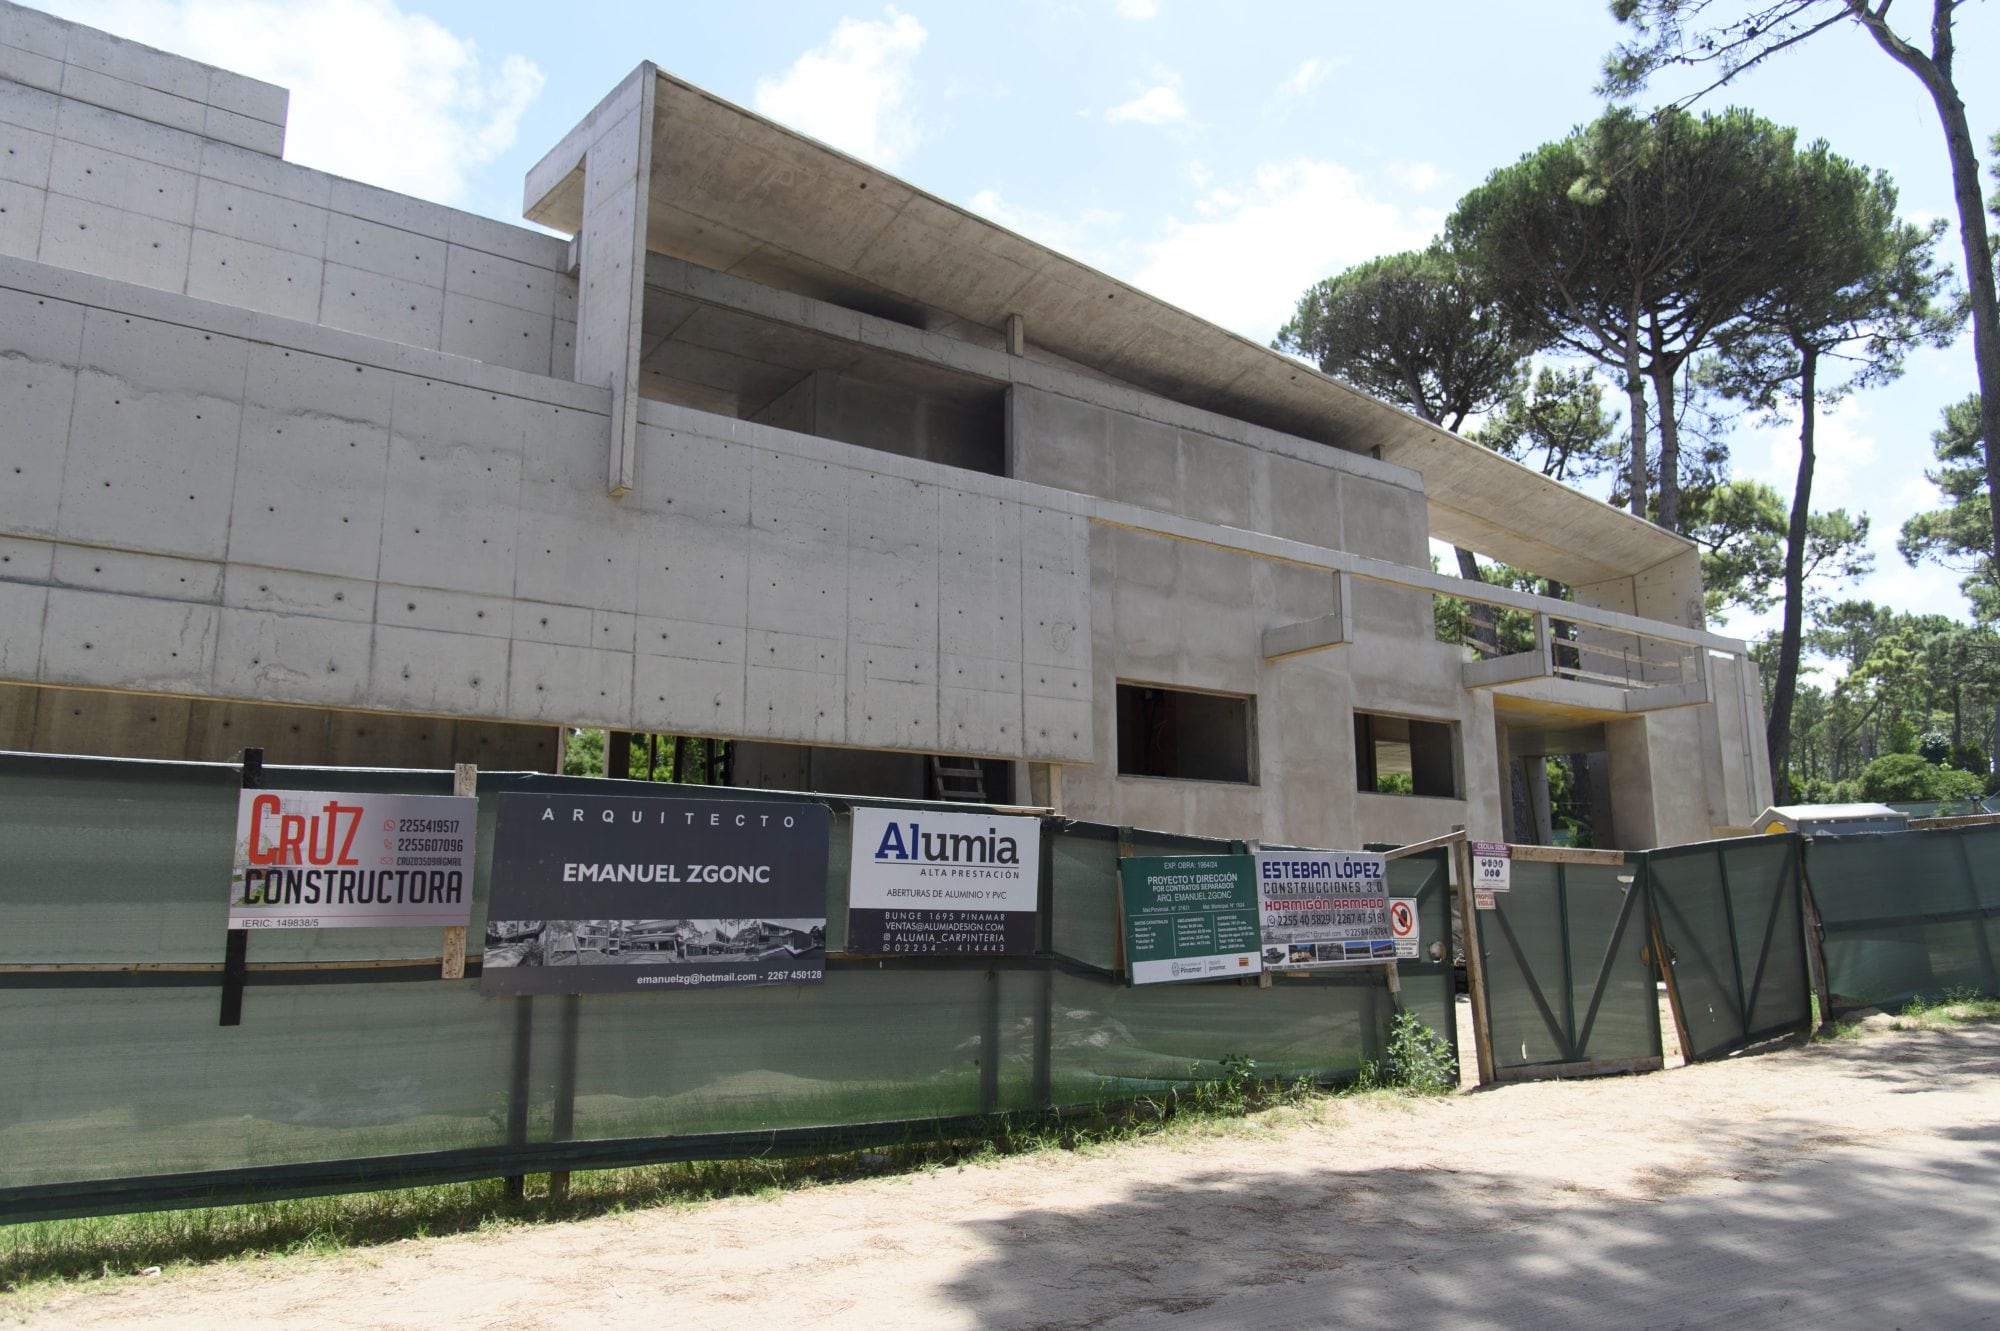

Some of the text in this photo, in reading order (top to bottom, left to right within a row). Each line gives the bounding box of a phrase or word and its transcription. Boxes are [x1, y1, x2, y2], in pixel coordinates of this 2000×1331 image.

[541, 807, 795, 829] ARQUITECTO
[399, 819, 460, 834] 2255419517
[398, 838, 463, 853] 2255607096
[874, 822, 1020, 864] Alumia
[563, 863, 770, 884] EMANUEL ZGONC
[920, 868, 1019, 879] ALTA PRESTACIÓN
[1262, 856, 1380, 879] ESTEBAN LÓPEZ
[1147, 872, 1238, 886] PROYECTO Y DIRECCIÓN
[244, 869, 463, 905] CONSTRUCTORA
[1166, 884, 1200, 892] CONTRATOS
[1200, 882, 1235, 890] SEPARADOS
[1263, 881, 1361, 894] CONSTRUCCIONES
[886, 889, 1007, 900] ABERTURAS DE ALUMINIO Y PVC
[1174, 892, 1207, 901] EMANUEL
[1207, 891, 1232, 900] ZGONC
[1264, 896, 1384, 911] HORMIGÓN ARMADO
[242, 918, 319, 928] IERIC: 149838/5
[885, 911, 1005, 921] BUNGE 1695 PINAMAR
[1277, 915, 1298, 927] 2255
[1300, 914, 1310, 926] 40
[1311, 914, 1331, 926] 5829
[1337, 913, 1355, 925] 2267
[1357, 913, 1366, 923] 47
[885, 922, 1005, 932] VENTAS@ALUMIADESIGN.COM
[896, 933, 1005, 943] ALUMIA_CARPINTERIA
[636, 971, 757, 985] emanuelzg@hotmail.com
[767, 971, 789, 981] 2267
[791, 969, 822, 980] 450128
